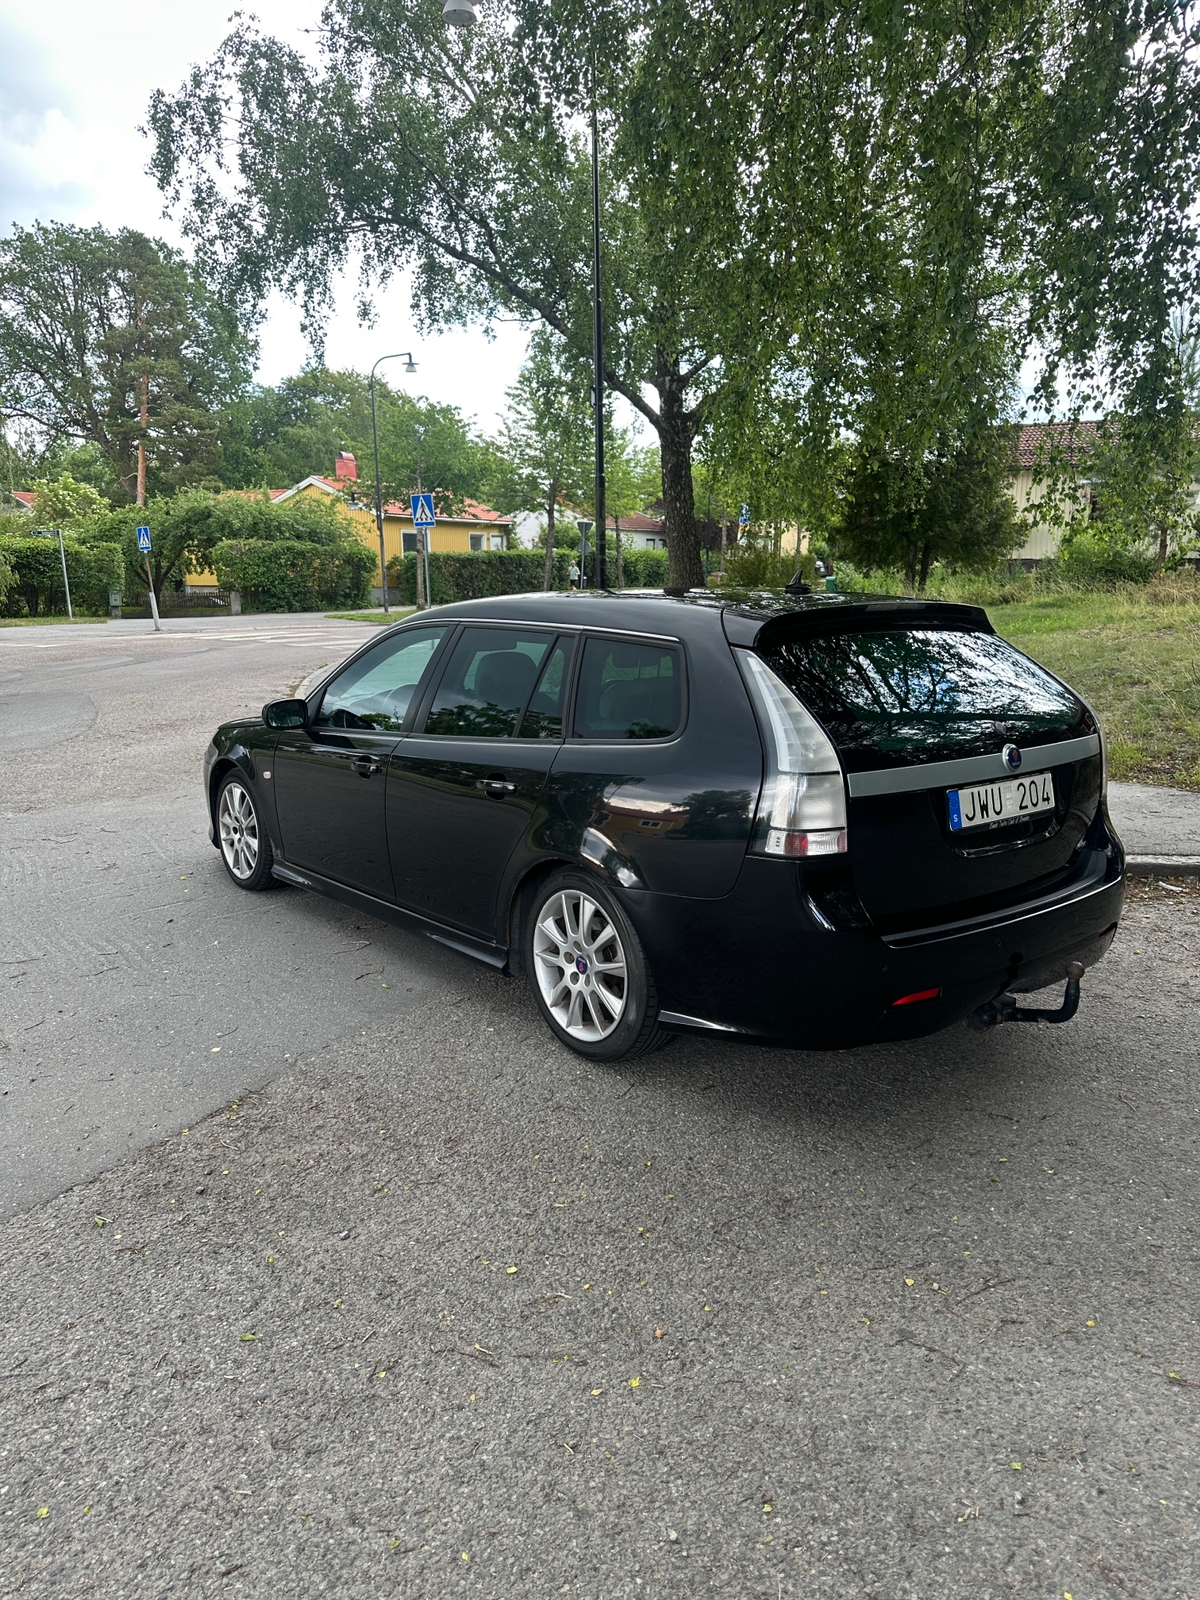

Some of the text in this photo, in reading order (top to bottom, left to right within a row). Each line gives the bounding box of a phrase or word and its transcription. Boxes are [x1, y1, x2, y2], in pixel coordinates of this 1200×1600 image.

[965, 786, 1003, 822] JWU
[1017, 778, 1050, 811] 204
[953, 814, 958, 823] S
